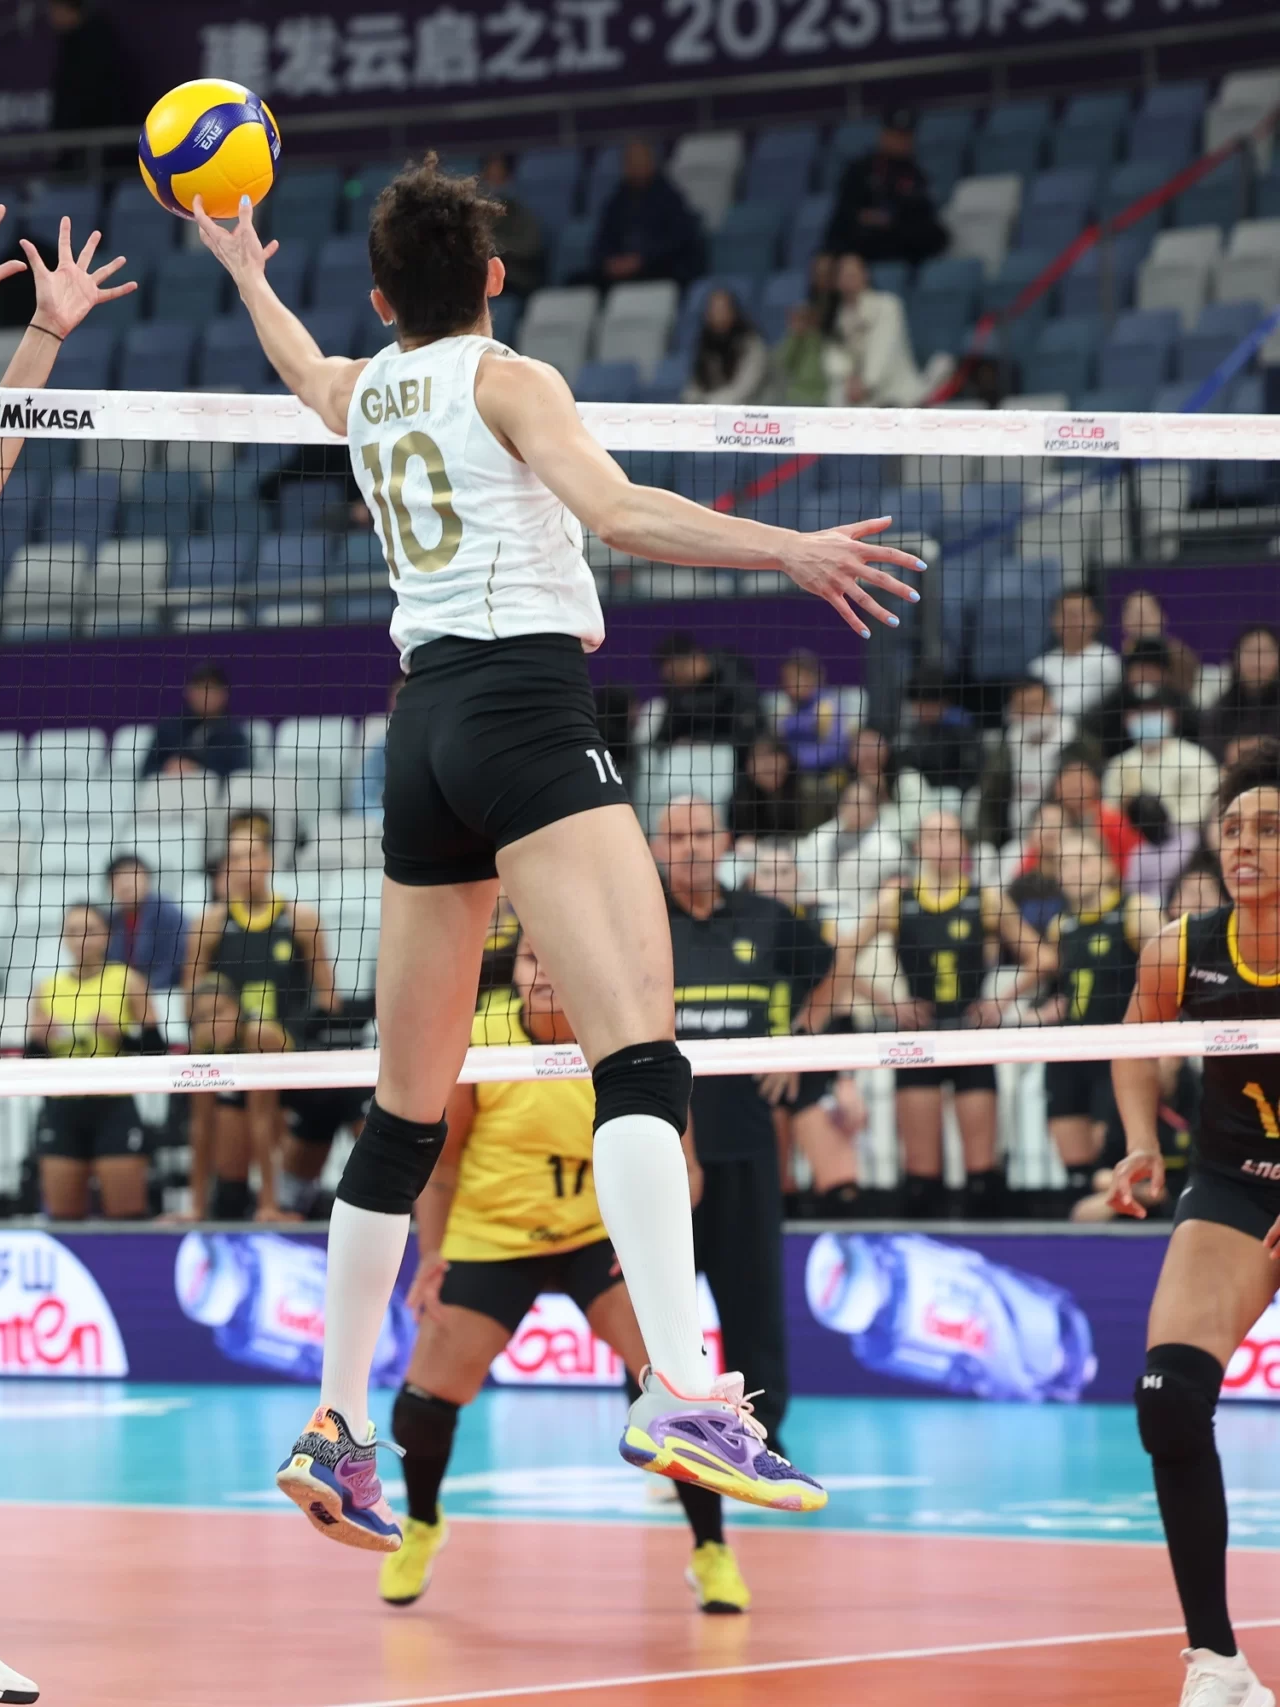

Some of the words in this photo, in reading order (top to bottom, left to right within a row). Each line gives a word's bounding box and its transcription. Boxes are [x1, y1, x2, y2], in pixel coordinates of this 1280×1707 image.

[200, 125, 223, 150] FIVB
[360, 376, 432, 425] GABI
[716, 435, 752, 446] WORLD
[733, 421, 780, 435] CLUB
[1058, 425, 1105, 438] CLUB
[361, 430, 463, 580] 10
[1242, 1081, 1280, 1139] 1
